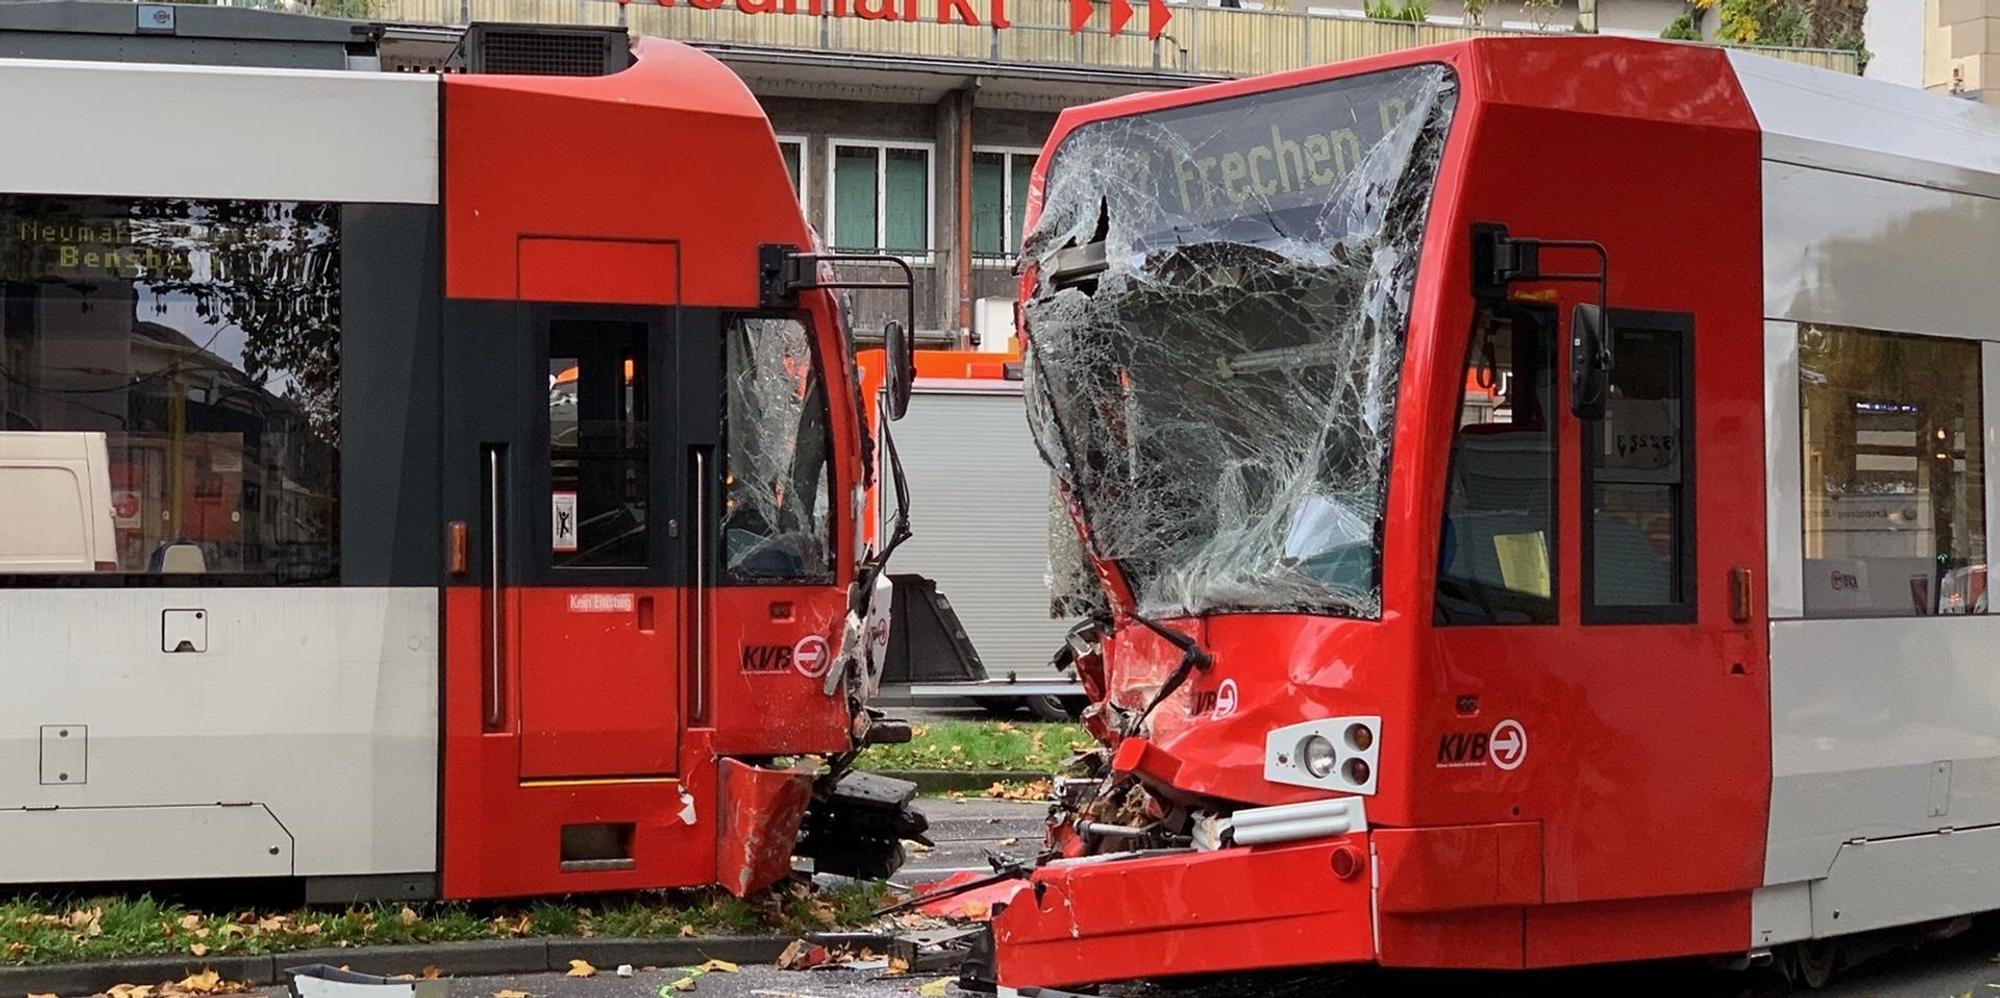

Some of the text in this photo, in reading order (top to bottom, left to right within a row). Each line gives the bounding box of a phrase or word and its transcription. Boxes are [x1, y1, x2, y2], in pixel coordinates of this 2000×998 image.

[1171, 124, 1362, 213] Frechen
[743, 645, 793, 671] KVB
[1437, 732, 1488, 762] KVB
